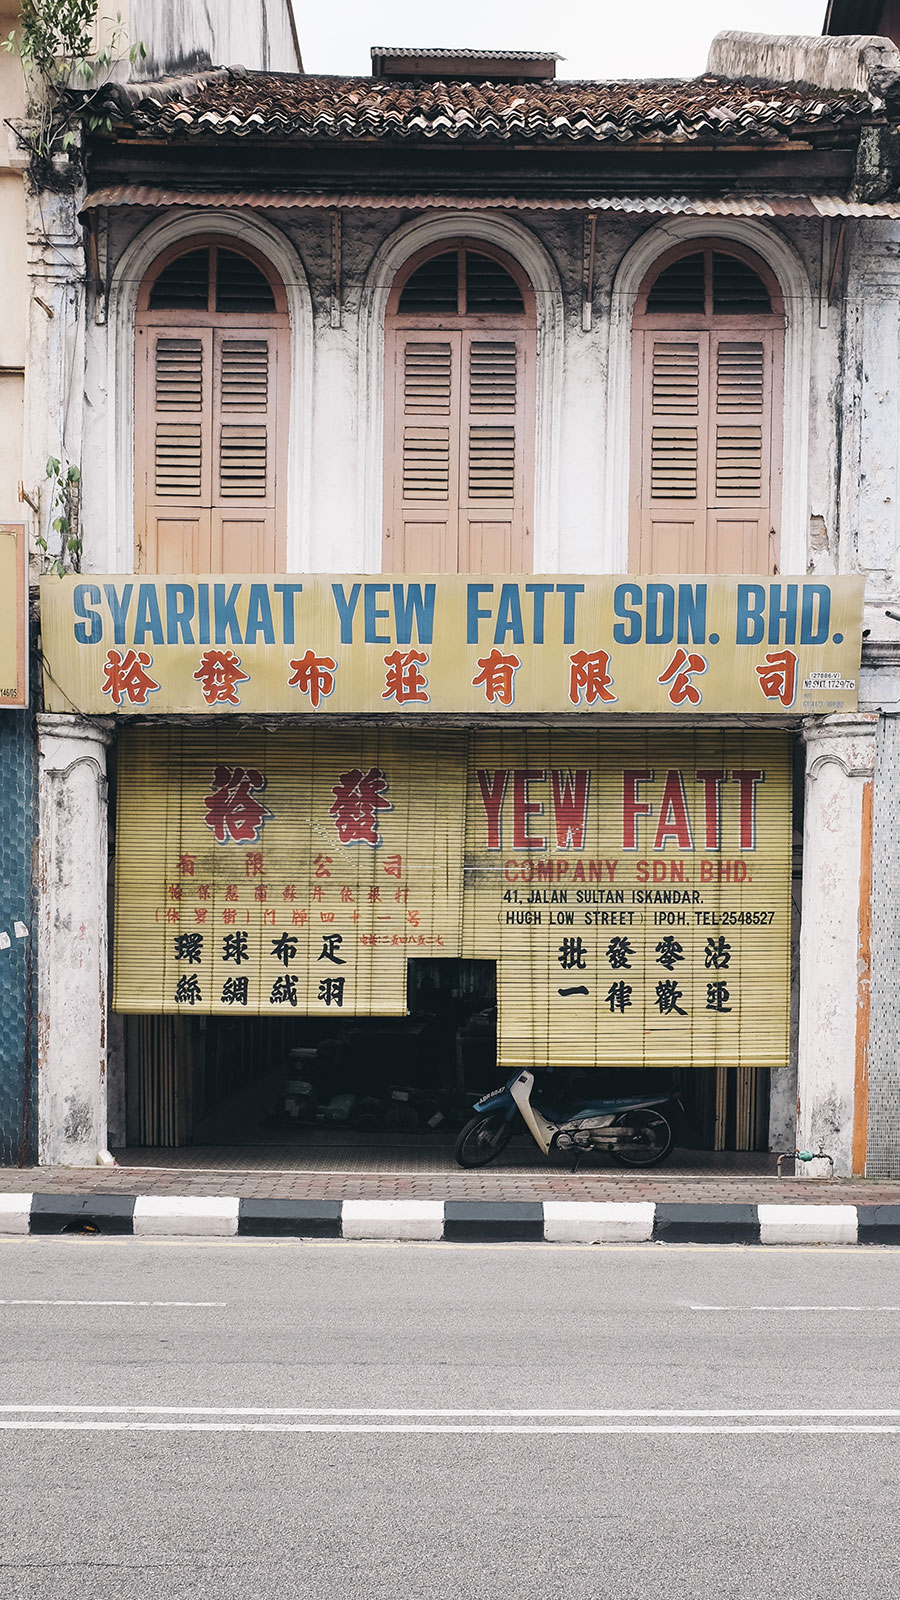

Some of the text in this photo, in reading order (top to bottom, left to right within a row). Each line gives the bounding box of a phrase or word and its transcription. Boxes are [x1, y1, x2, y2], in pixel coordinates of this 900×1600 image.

[74, 583, 844, 645] SYARIKAT YEW FATT SDN. BHD.
[204, 764, 395, 848] 裕發
[476, 768, 766, 852] YEW FATT
[176, 851, 403, 880] 有限公司
[504, 859, 753, 882] COMPANY SDN. BHD.
[503, 889, 704, 905] 41, JALAN SULTAN ISKANDAR.
[549, 910, 575, 925] LOW
[654, 910, 690, 927] IPOH,
